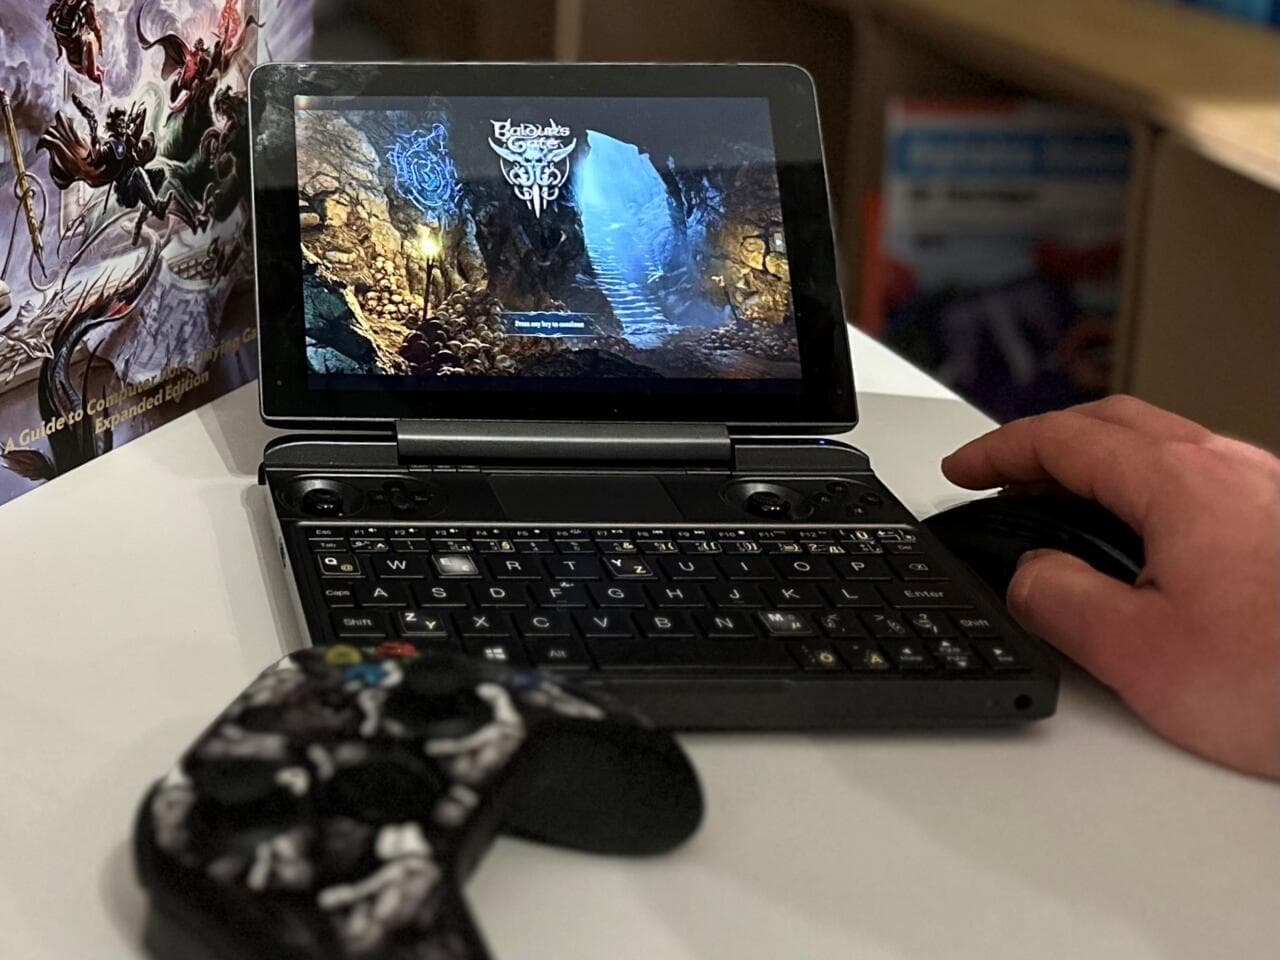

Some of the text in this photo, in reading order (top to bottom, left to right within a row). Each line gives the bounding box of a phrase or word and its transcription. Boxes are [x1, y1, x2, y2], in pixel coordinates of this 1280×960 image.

[489, 118, 571, 141] Baldur's
[94, 371, 210, 434] Expanded Edition
[4, 437, 16, 455] A
[19, 416, 65, 447] Guide
[67, 409, 84, 425] to
[86, 374, 158, 416] Computer
[324, 557, 338, 565] Q
[386, 560, 406, 570] W
[506, 561, 521, 570] R
[563, 561, 576, 570] T
[611, 559, 622, 567] Y
[633, 565, 647, 573] Z
[678, 562, 695, 571] U
[740, 561, 749, 571] I
[793, 561, 811, 572] O
[850, 561, 865, 571] P
[373, 587, 389, 598] A
[431, 587, 447, 598] S
[489, 588, 505, 598] D
[549, 588, 563, 598] F
[607, 588, 625, 598] G
[666, 588, 684, 599] H
[729, 589, 740, 599] J
[781, 589, 801, 599] K
[841, 589, 859, 598] L
[903, 590, 945, 598] Enter
[343, 618, 373, 626] Shift
[404, 612, 417, 621] Z
[425, 620, 436, 629] Y
[473, 616, 490, 627] X
[532, 617, 550, 627] C
[593, 617, 608, 627] V
[654, 617, 672, 628] B
[714, 617, 734, 628] N
[767, 613, 785, 622] M
